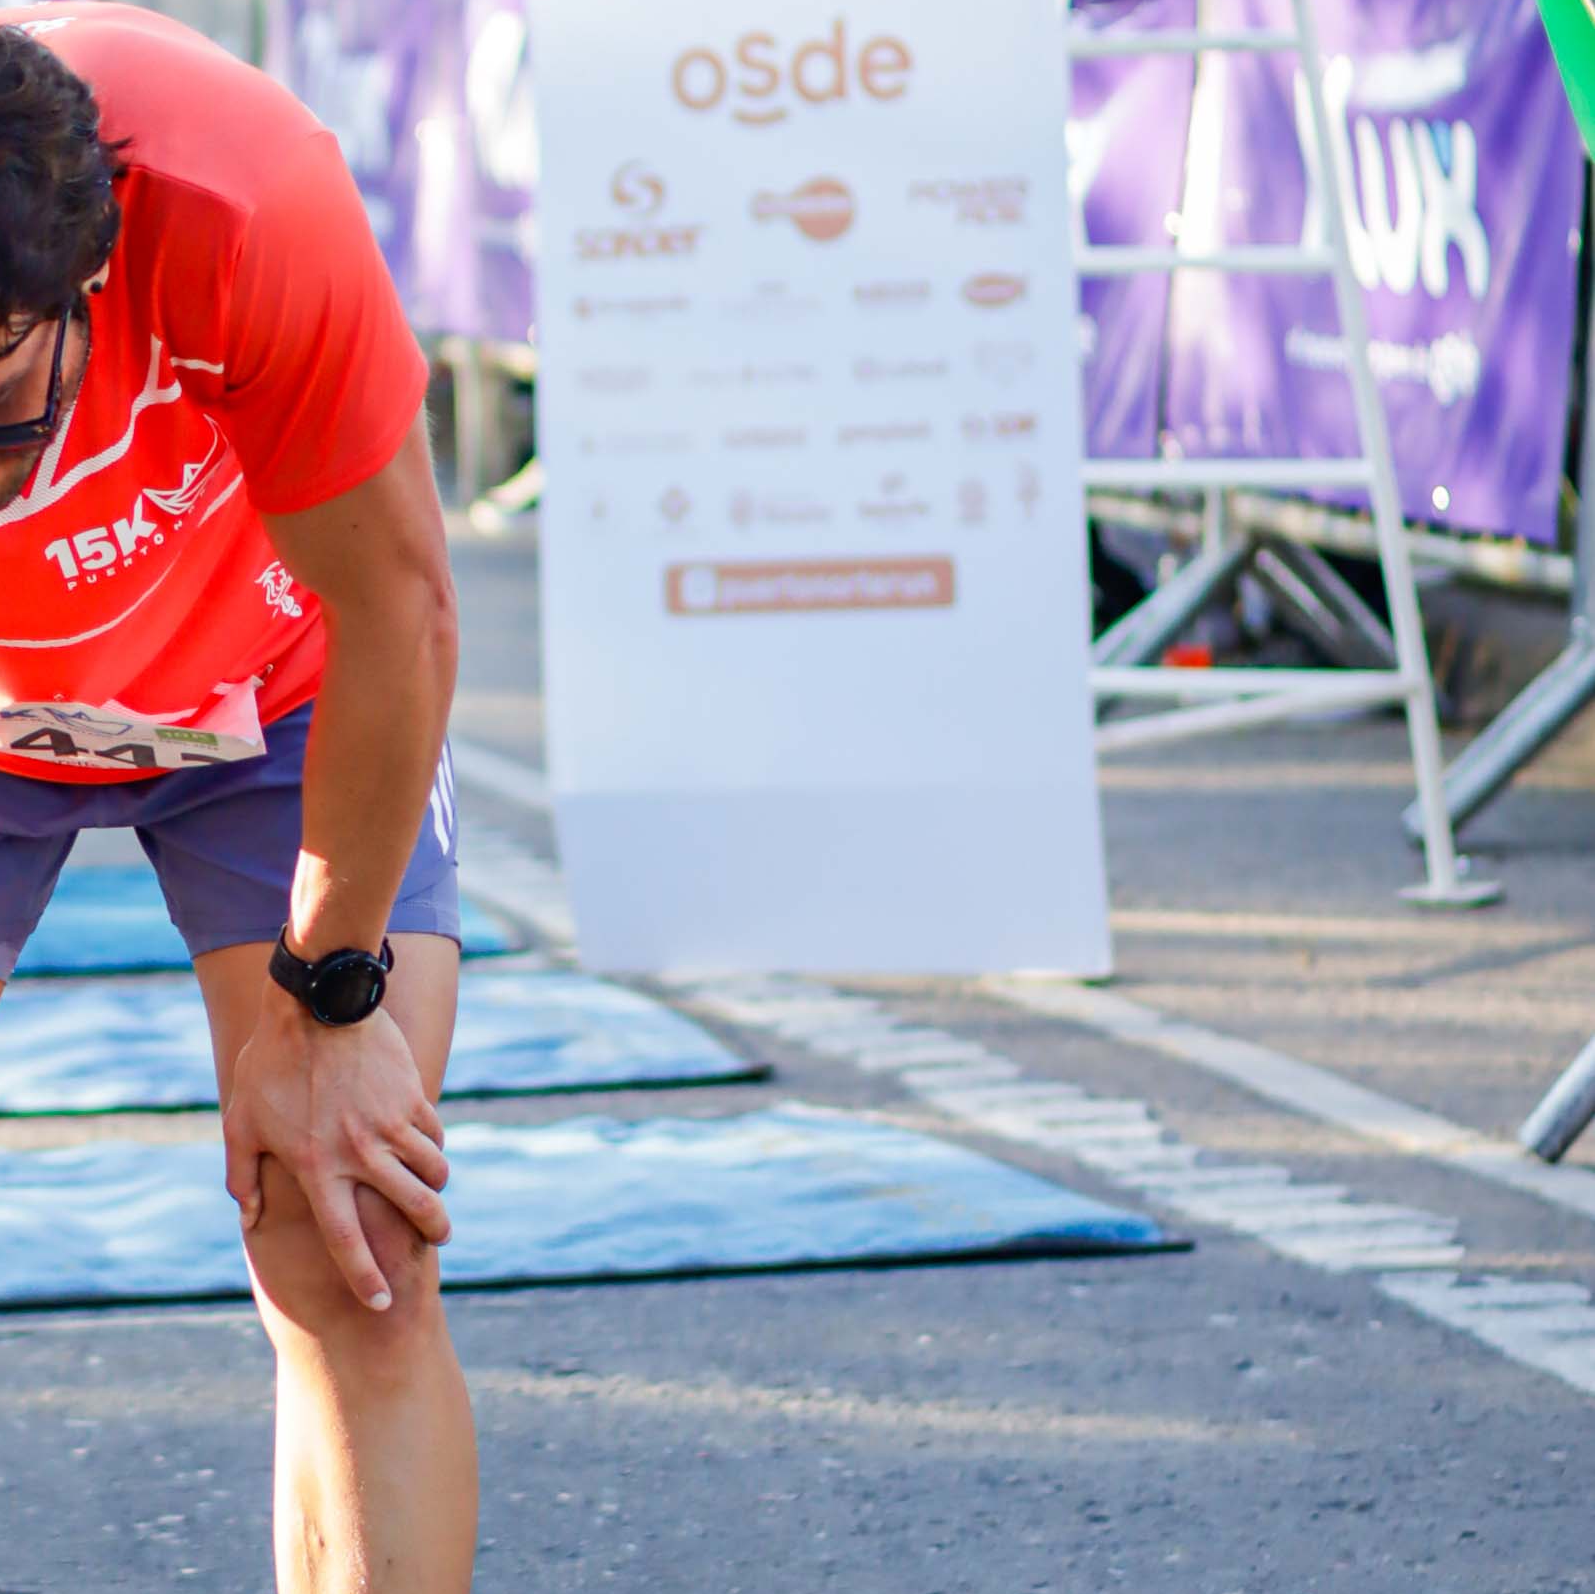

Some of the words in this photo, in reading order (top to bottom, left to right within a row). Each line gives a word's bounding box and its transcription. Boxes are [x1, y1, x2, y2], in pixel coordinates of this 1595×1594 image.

[670, 17, 914, 113] osde
[44, 494, 157, 579] 15K
[66, 533, 164, 591] PUERTO
